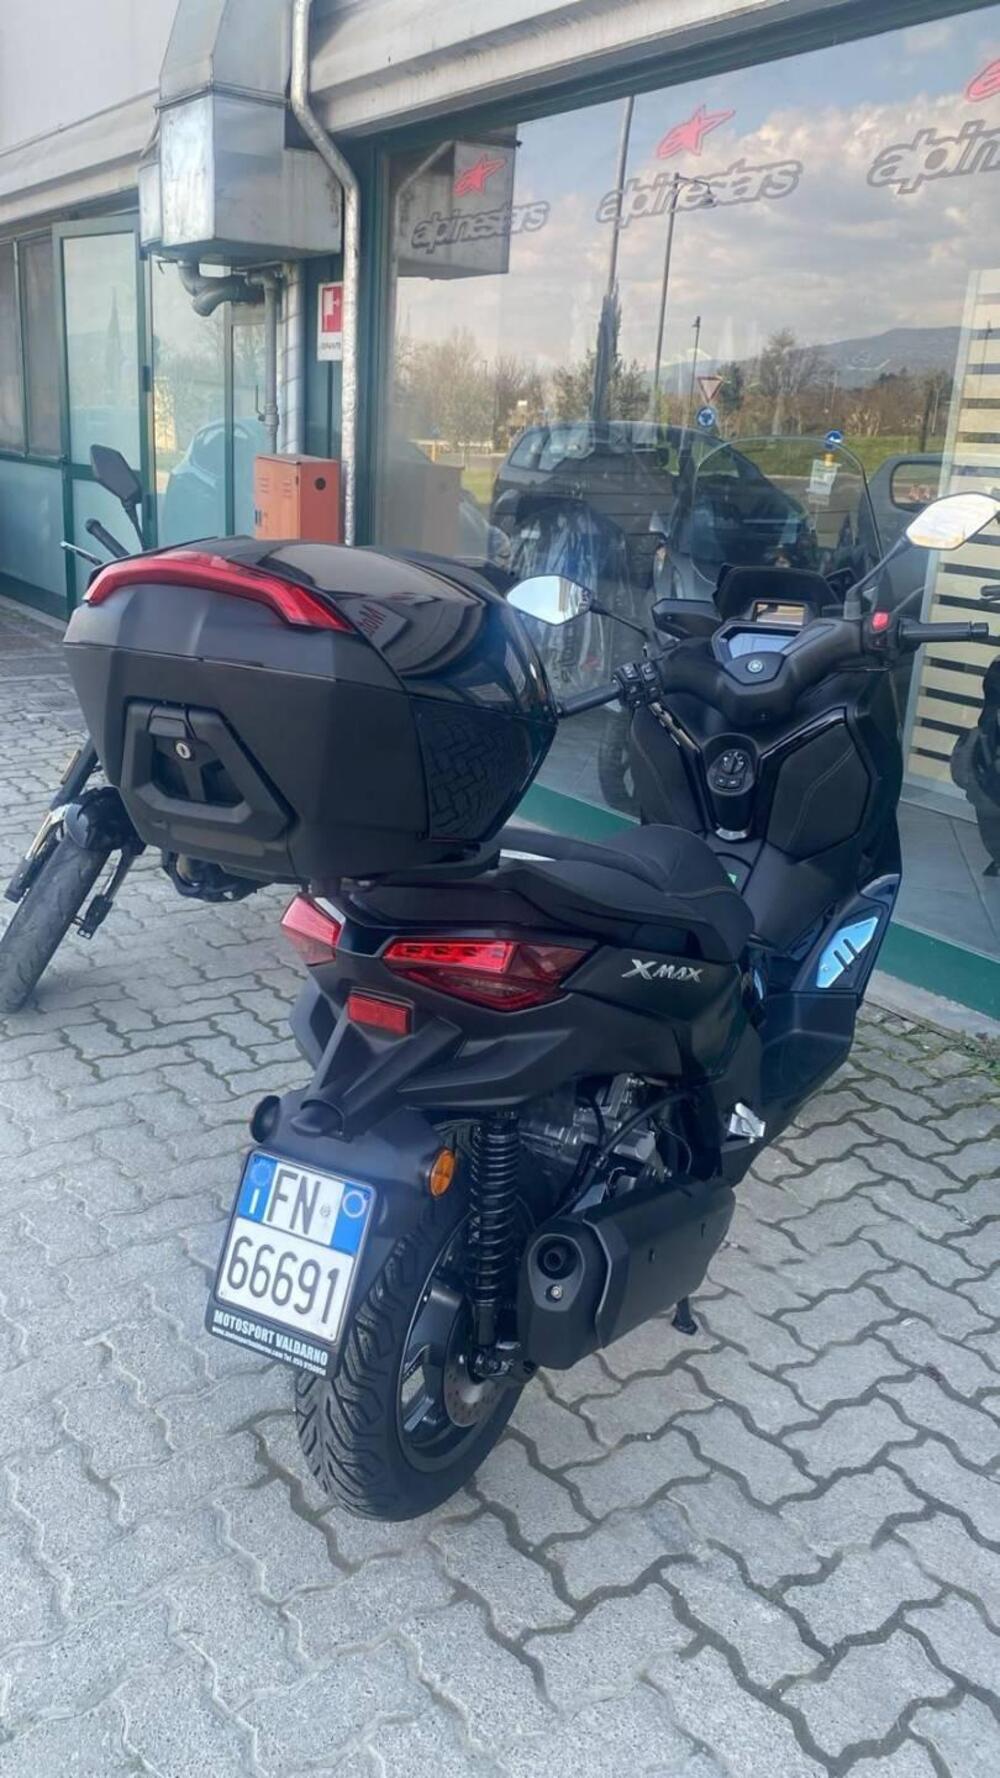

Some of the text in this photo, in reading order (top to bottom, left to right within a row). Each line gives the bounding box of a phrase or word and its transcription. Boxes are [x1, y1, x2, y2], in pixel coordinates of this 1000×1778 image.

[595, 158, 804, 229] alpinestars
[411, 200, 551, 255] alpinestars
[266, 1168, 321, 1235] FN
[226, 1235, 341, 1325] 66691
[213, 1309, 276, 1345] MOTOSPORT
[275, 1332, 329, 1367] VALDARNO
